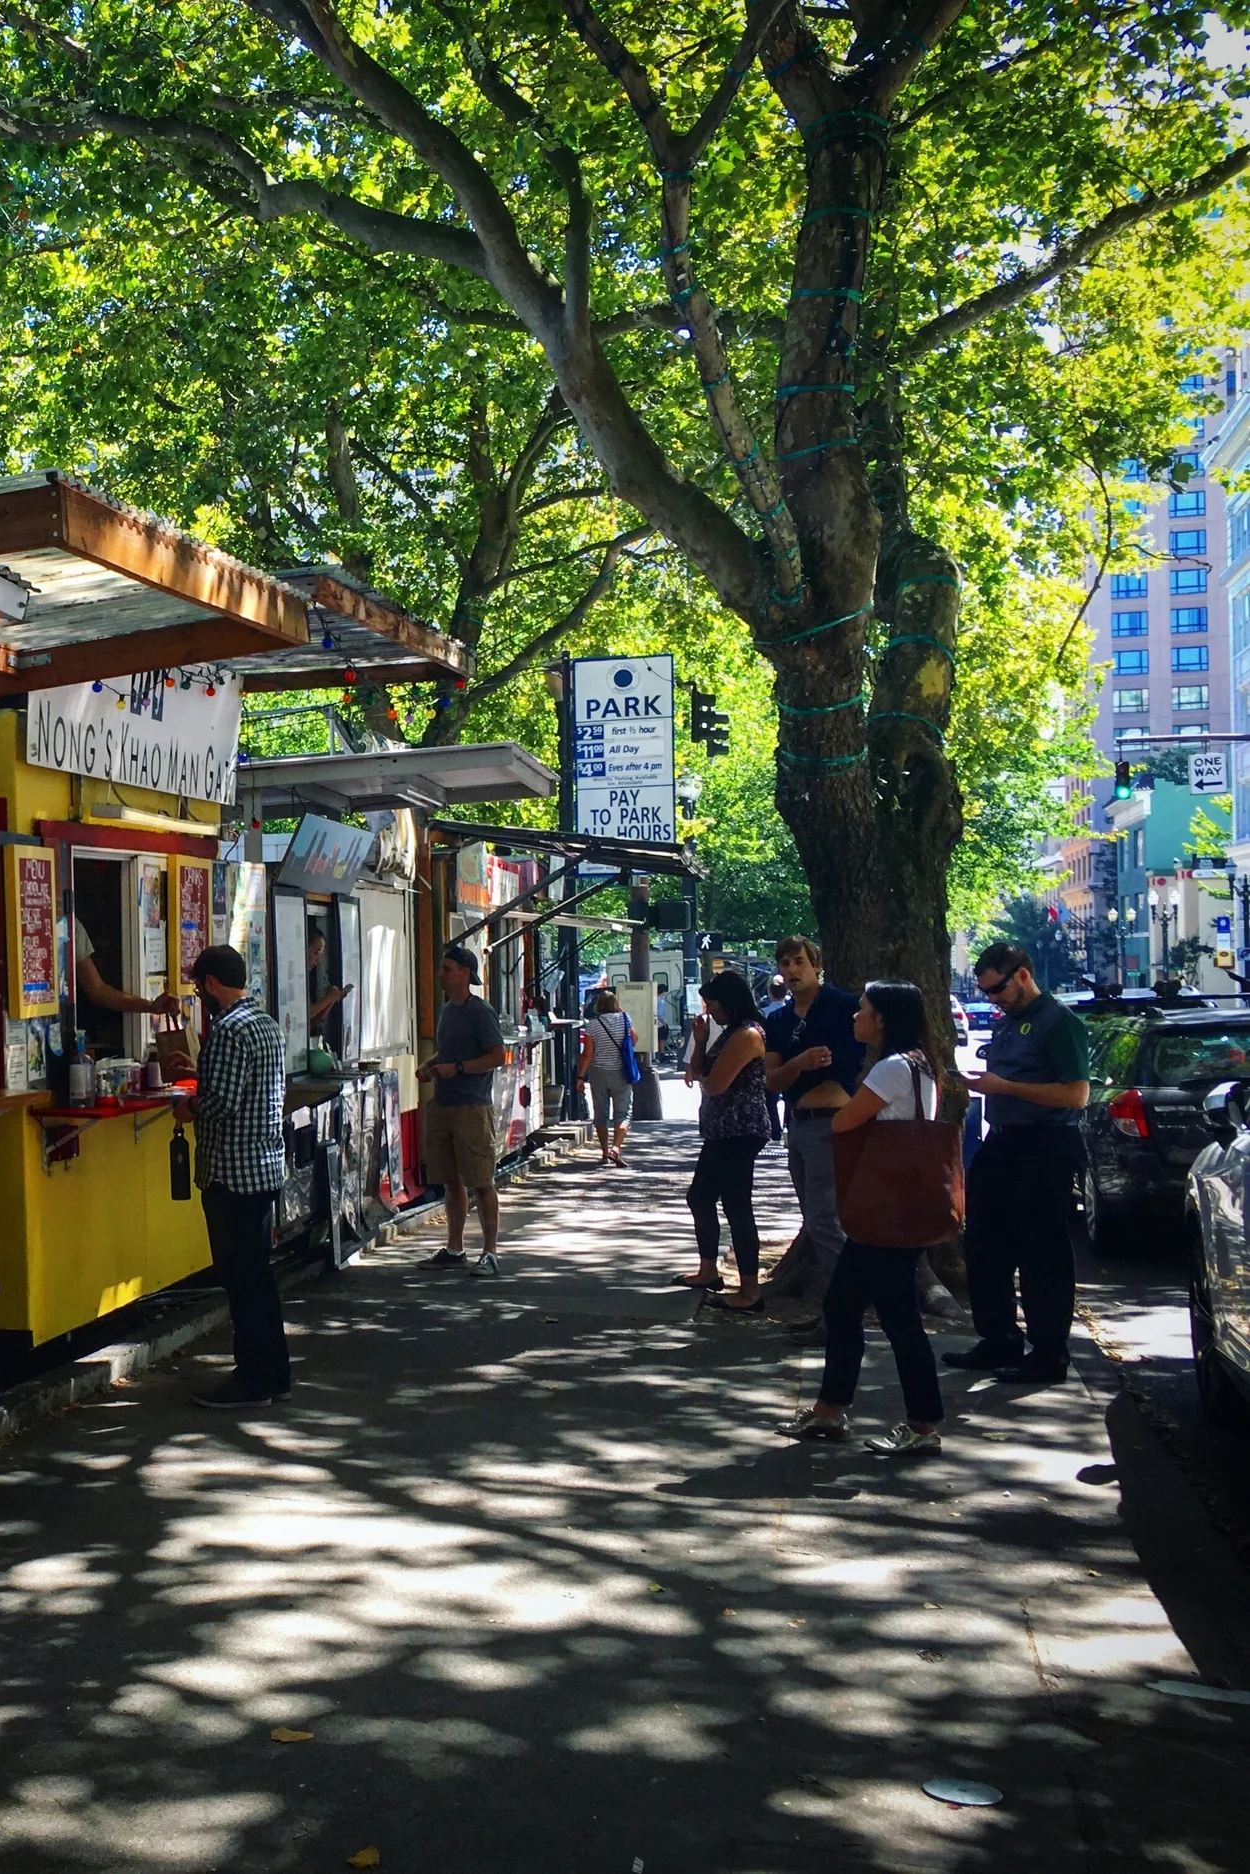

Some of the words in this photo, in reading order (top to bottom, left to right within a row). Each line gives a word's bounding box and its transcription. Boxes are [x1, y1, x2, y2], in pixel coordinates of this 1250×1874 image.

[586, 695, 662, 719] PARK
[611, 727, 627, 736] first
[638, 725, 656, 734] hour
[118, 721, 162, 788] KHAO
[166, 737, 200, 795] MAN
[608, 745, 621, 754] All
[622, 745, 640, 755] Day
[608, 764, 623, 772] Eves
[625, 763, 642, 772] after
[643, 762, 649, 771] 4
[650, 763, 662, 772] pm
[1193, 756, 1222, 767] ONE
[1193, 766, 1223, 777] WAY
[609, 789, 640, 808] PAY
[590, 809, 612, 826] TO
[620, 806, 662, 824] PARK
[617, 823, 671, 841] HOURS
[25, 859, 46, 880] MENU
